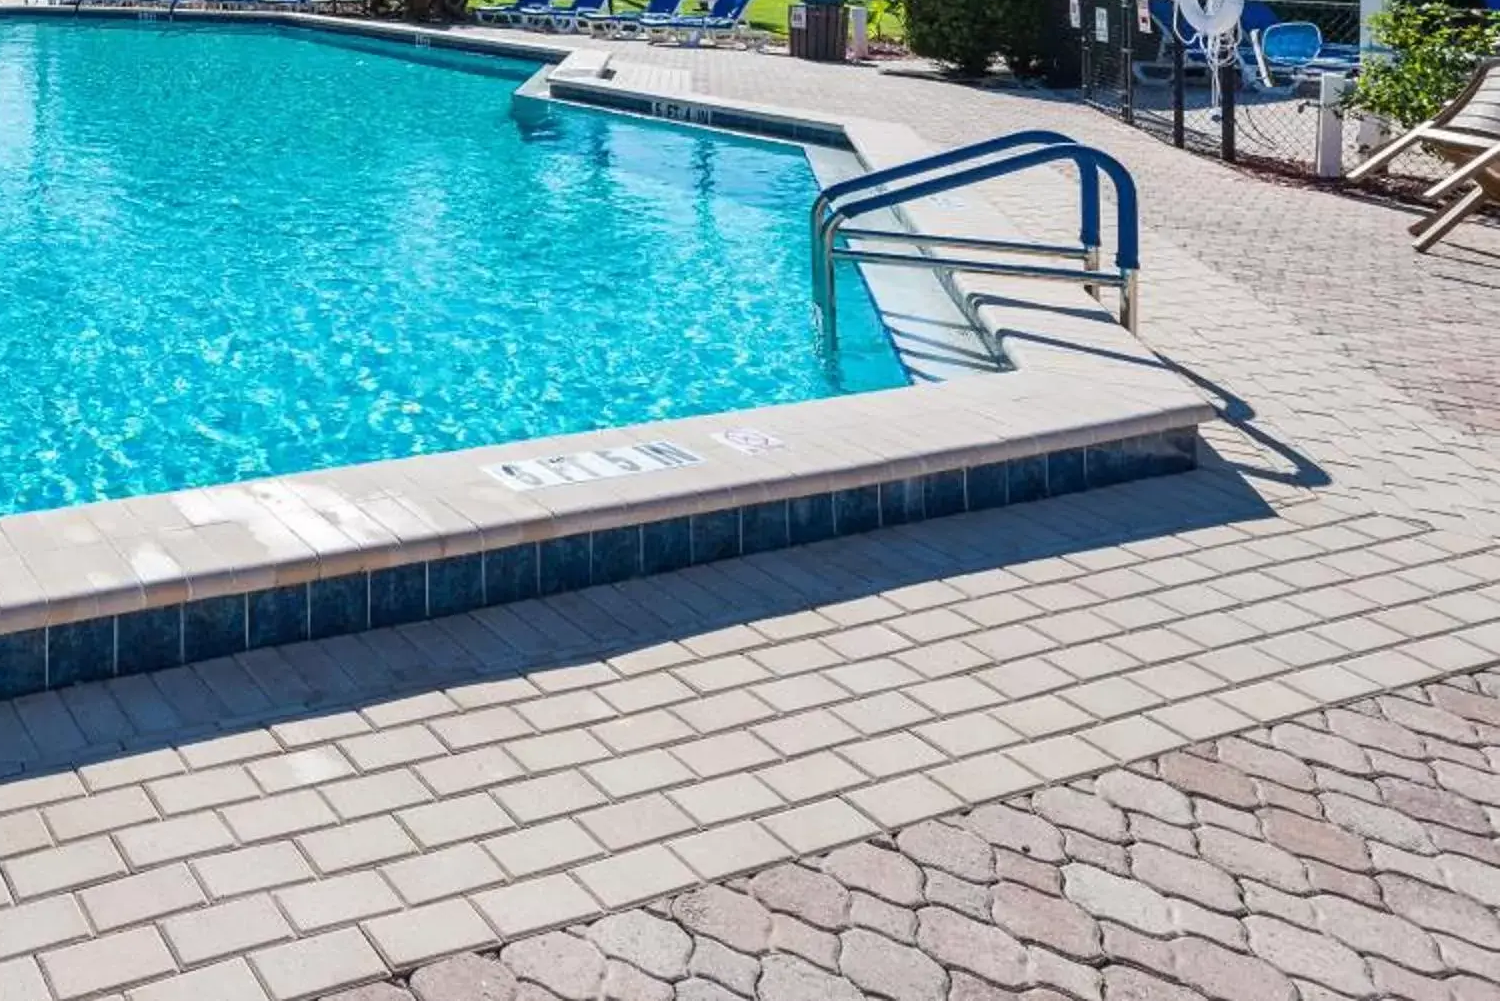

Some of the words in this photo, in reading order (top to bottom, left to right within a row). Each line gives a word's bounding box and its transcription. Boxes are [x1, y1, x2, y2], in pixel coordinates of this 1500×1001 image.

[536, 455, 601, 482] FT
[595, 449, 643, 472] 5
[632, 439, 700, 467] IN
